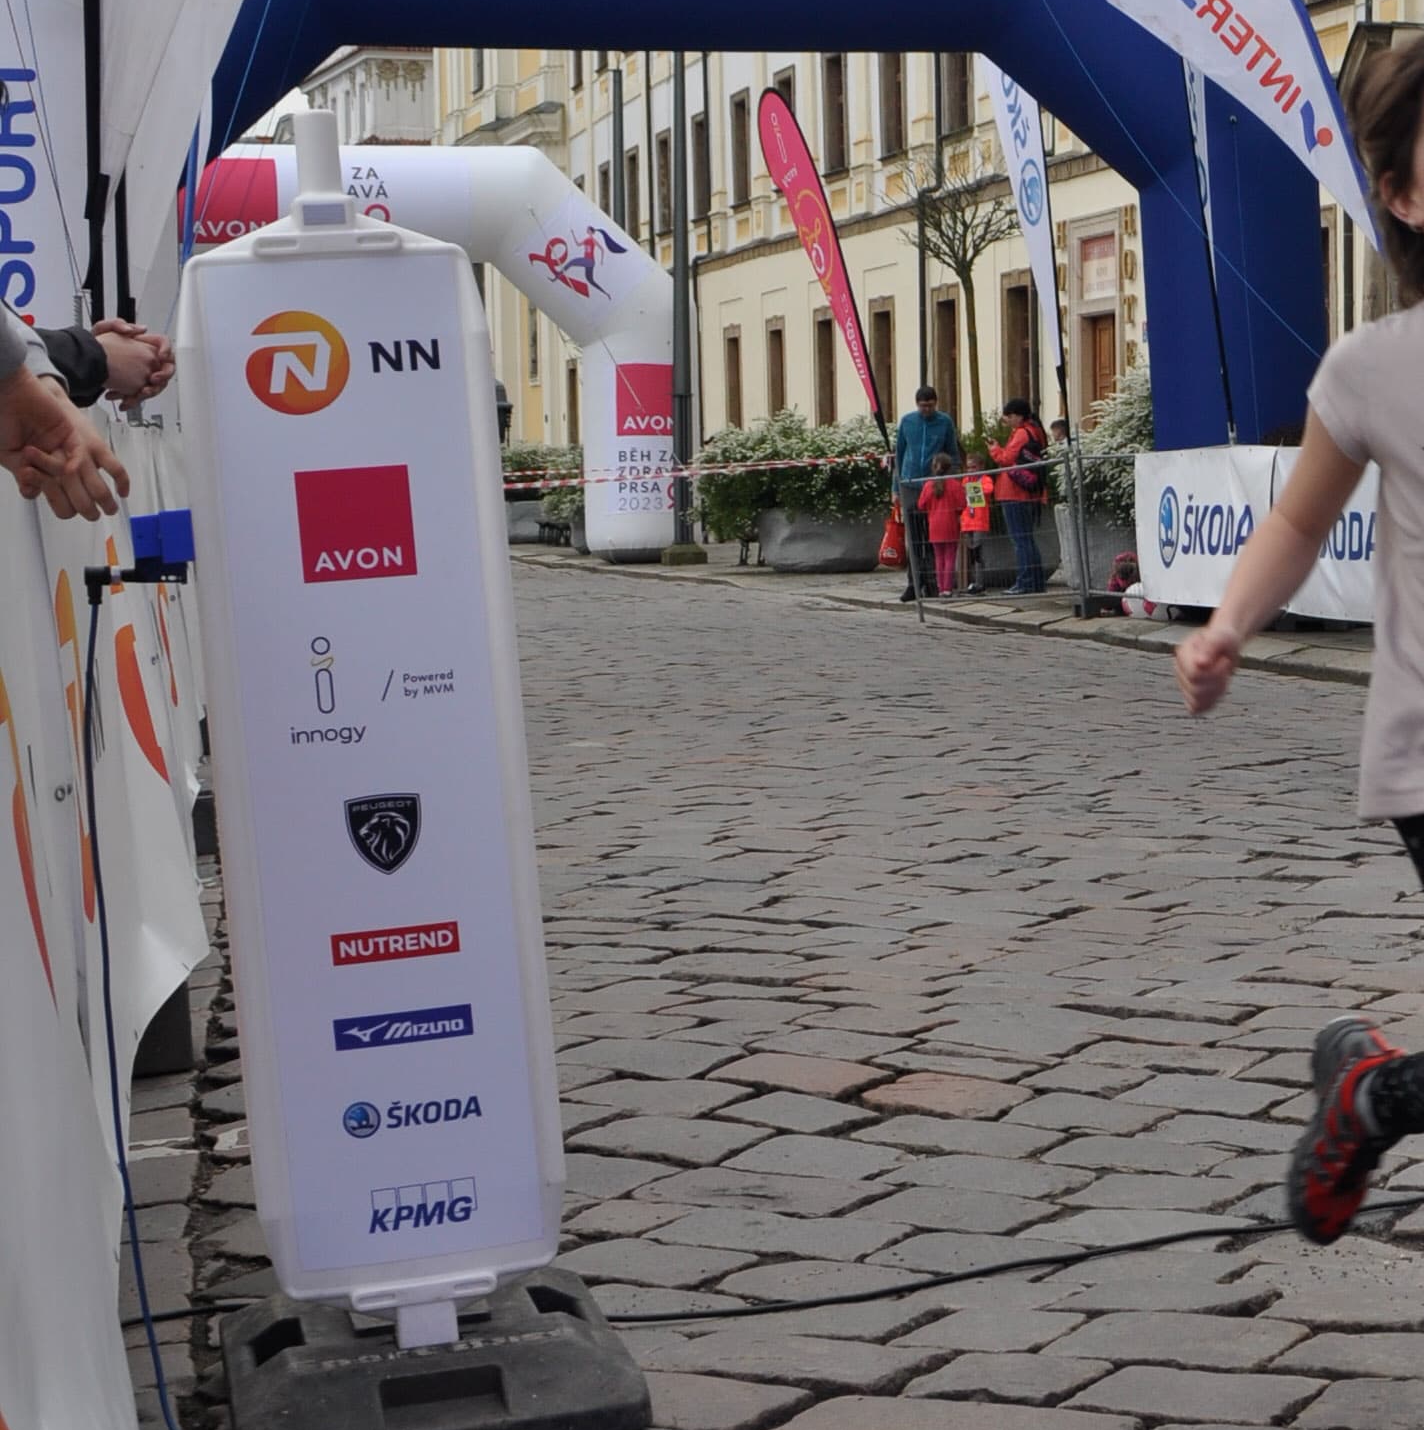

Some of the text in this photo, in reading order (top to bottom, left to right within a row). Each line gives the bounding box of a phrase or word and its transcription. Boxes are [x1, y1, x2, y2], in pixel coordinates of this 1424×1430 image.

[368, 339, 441, 373] NN
[1181, 494, 1255, 556] ŠKODA
[315, 545, 403, 572] AVON
[403, 669, 454, 683] Powered
[403, 683, 454, 698] by MVM
[290, 725, 367, 745] innogy
[339, 929, 454, 959] NUTREND
[386, 1096, 483, 1130] ŠKODA
[369, 1196, 473, 1234] KPMG
